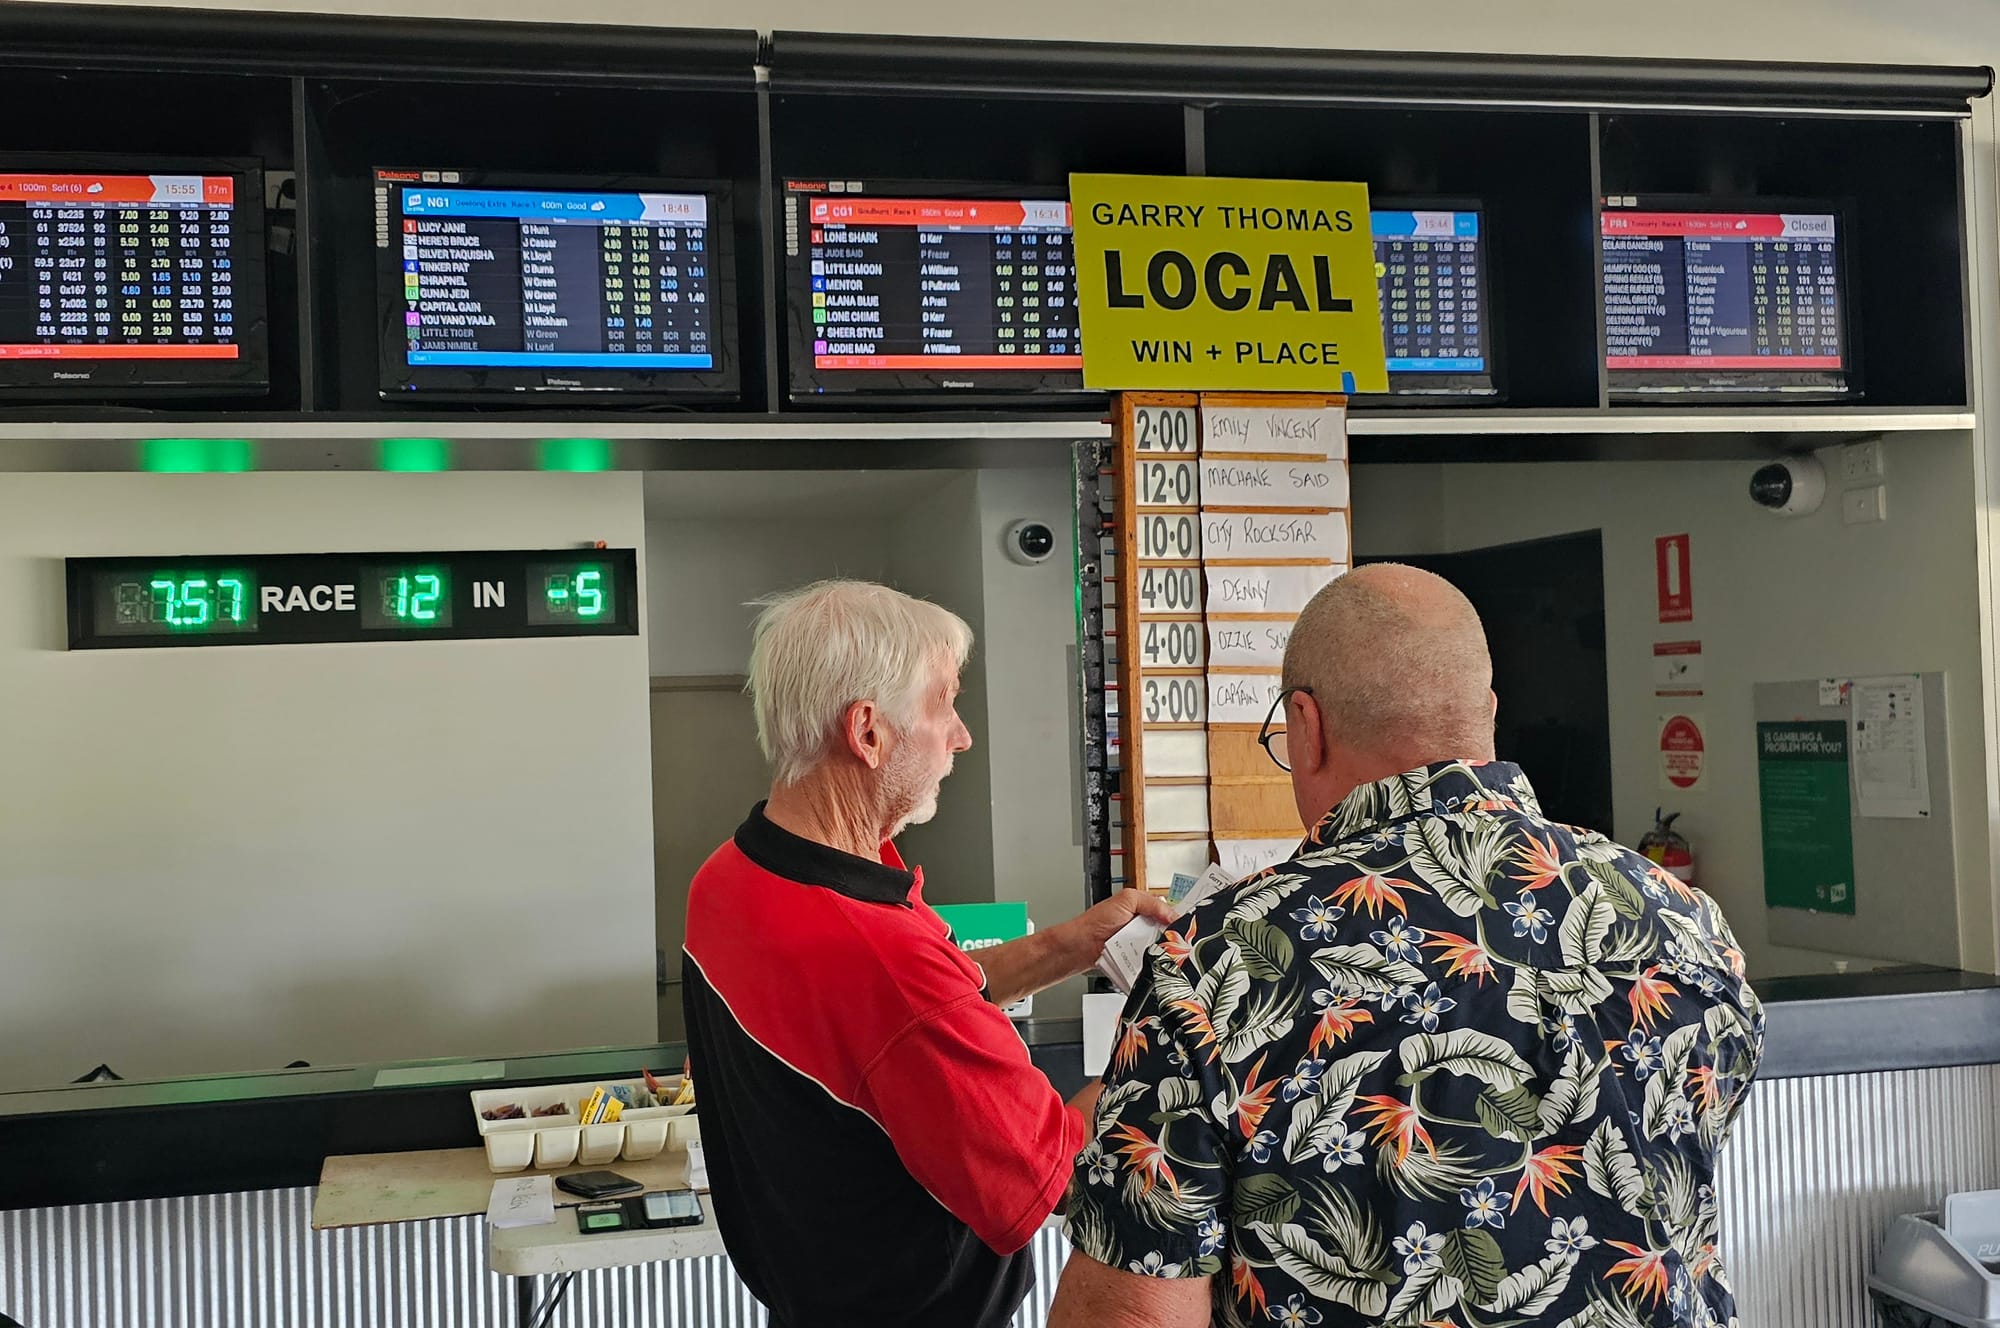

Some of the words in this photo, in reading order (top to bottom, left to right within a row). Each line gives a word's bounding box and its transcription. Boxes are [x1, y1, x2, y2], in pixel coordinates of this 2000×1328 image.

[19, 183, 47, 191] 1000m
[52, 183, 69, 191] Soft
[70, 183, 82, 193] (6)
[164, 184, 195, 194] 15:55
[208, 185, 227, 194] 17m
[427, 197, 450, 208] NG1
[541, 202, 562, 210] 400m
[567, 202, 586, 210] Good
[662, 203, 689, 213] 18:48
[119, 211, 138, 220] 7.00
[1092, 203, 1205, 228] GARRY
[1217, 206, 1353, 232] THOMAS
[418, 222, 441, 233] LUCY
[441, 223, 466, 233] JANE
[1791, 220, 1827, 232] Closed
[824, 231, 847, 243] LONE
[848, 231, 878, 244] SHARK
[418, 248, 449, 260] SILVER
[419, 262, 451, 272] TINKER
[453, 263, 470, 273] PAT
[826, 279, 863, 291] MENTOR
[1104, 250, 1353, 313] LOCAL
[125, 299, 136, 308] 31
[420, 302, 457, 312] CAPITAL
[458, 302, 482, 312] GAIN
[152, 313, 172, 322] 2.10
[422, 329, 449, 337] LITTLE
[450, 329, 474, 338] TIGER
[447, 342, 479, 351] NIMBLE
[1132, 340, 1192, 364] WIN
[1206, 345, 1222, 360] +
[1235, 342, 1339, 365] PLACE
[1212, 415, 1250, 444] EMILY
[1266, 416, 1321, 441] VINCENT
[1208, 468, 1272, 488] MACHANE
[1289, 468, 1329, 489] SAID
[1207, 525, 1232, 551] CITY
[1244, 516, 1317, 544] ROCKSTAR
[260, 584, 356, 613] RACE
[397, 574, 440, 619] 12
[472, 581, 506, 608] IN
[1222, 579, 1270, 608] DENNY
[1218, 630, 1256, 651] OZZIE
[1216, 680, 1259, 707] CAPTAIN
[1773, 731, 1815, 742] GAMBLING
[1764, 742, 1800, 753] PROBLEM
[1802, 742, 1819, 753] FOR
[1820, 742, 1842, 753] YOU?
